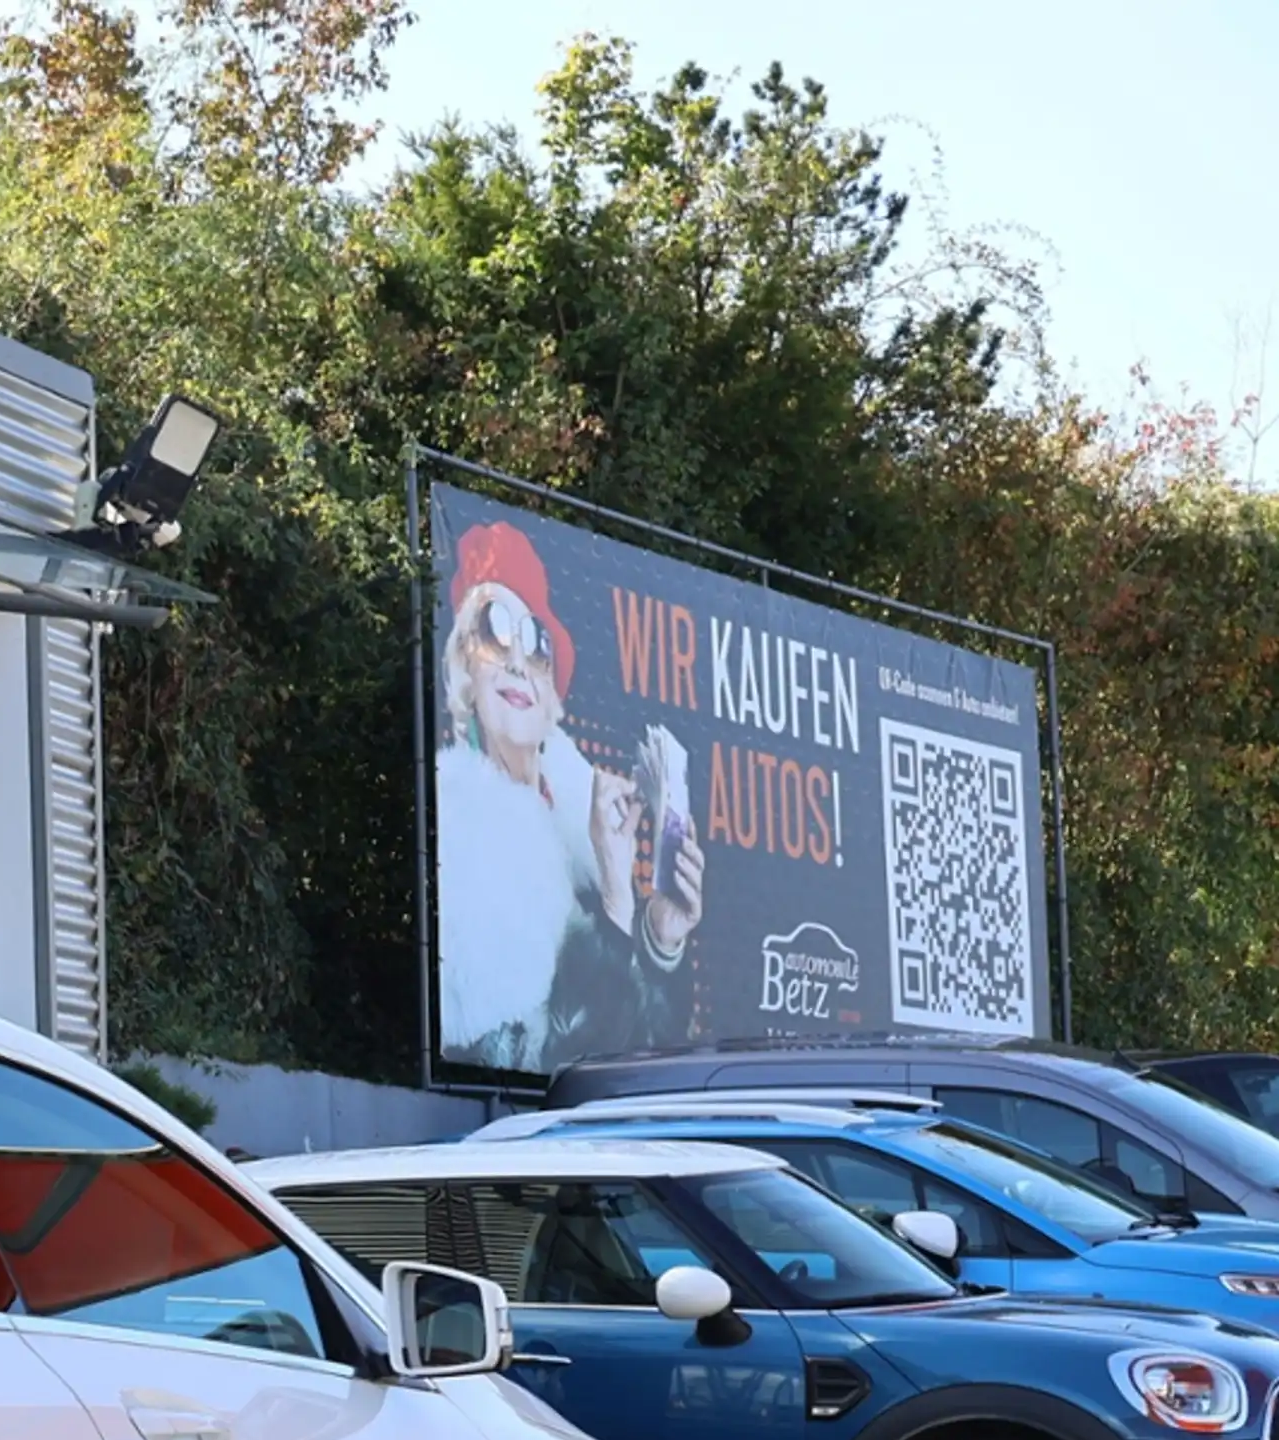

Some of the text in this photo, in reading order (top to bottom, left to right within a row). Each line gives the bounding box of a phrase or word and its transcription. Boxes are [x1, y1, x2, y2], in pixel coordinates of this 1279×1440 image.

[612, 586, 860, 753] WIR KAUFEN
[708, 742, 844, 868] AUTOS!
[759, 949, 830, 1018] Betz
